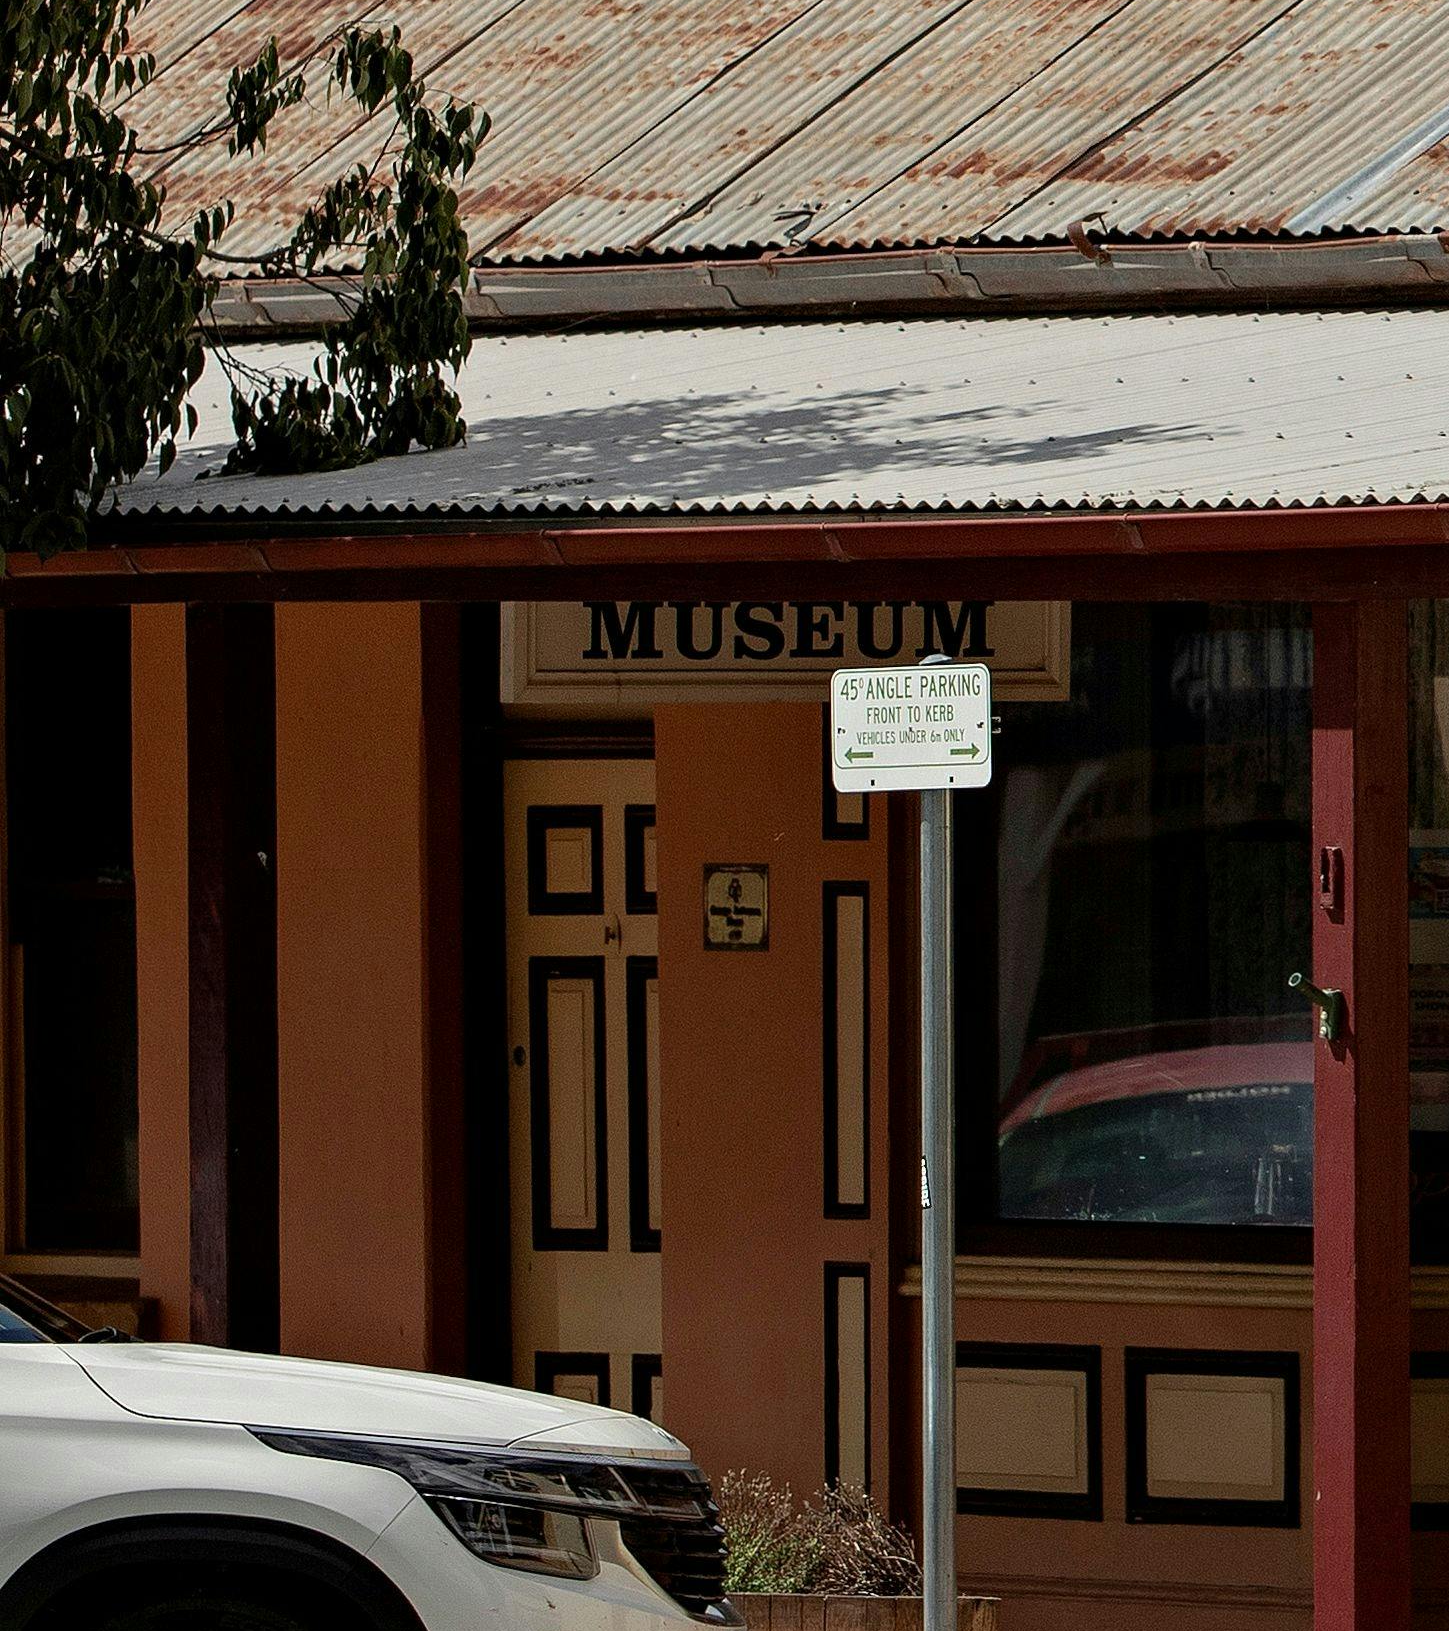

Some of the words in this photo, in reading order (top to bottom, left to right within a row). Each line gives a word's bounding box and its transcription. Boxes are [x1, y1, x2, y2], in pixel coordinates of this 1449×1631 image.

[582, 600, 996, 661] MUSEUM
[920, 673, 981, 698] PARKING
[866, 706, 902, 724] FRONT
[907, 705, 921, 723] TO
[925, 704, 954, 722] KERB
[856, 731, 896, 745] VEHICLES
[900, 729, 926, 744] UNDER
[943, 728, 965, 742] ONLY
